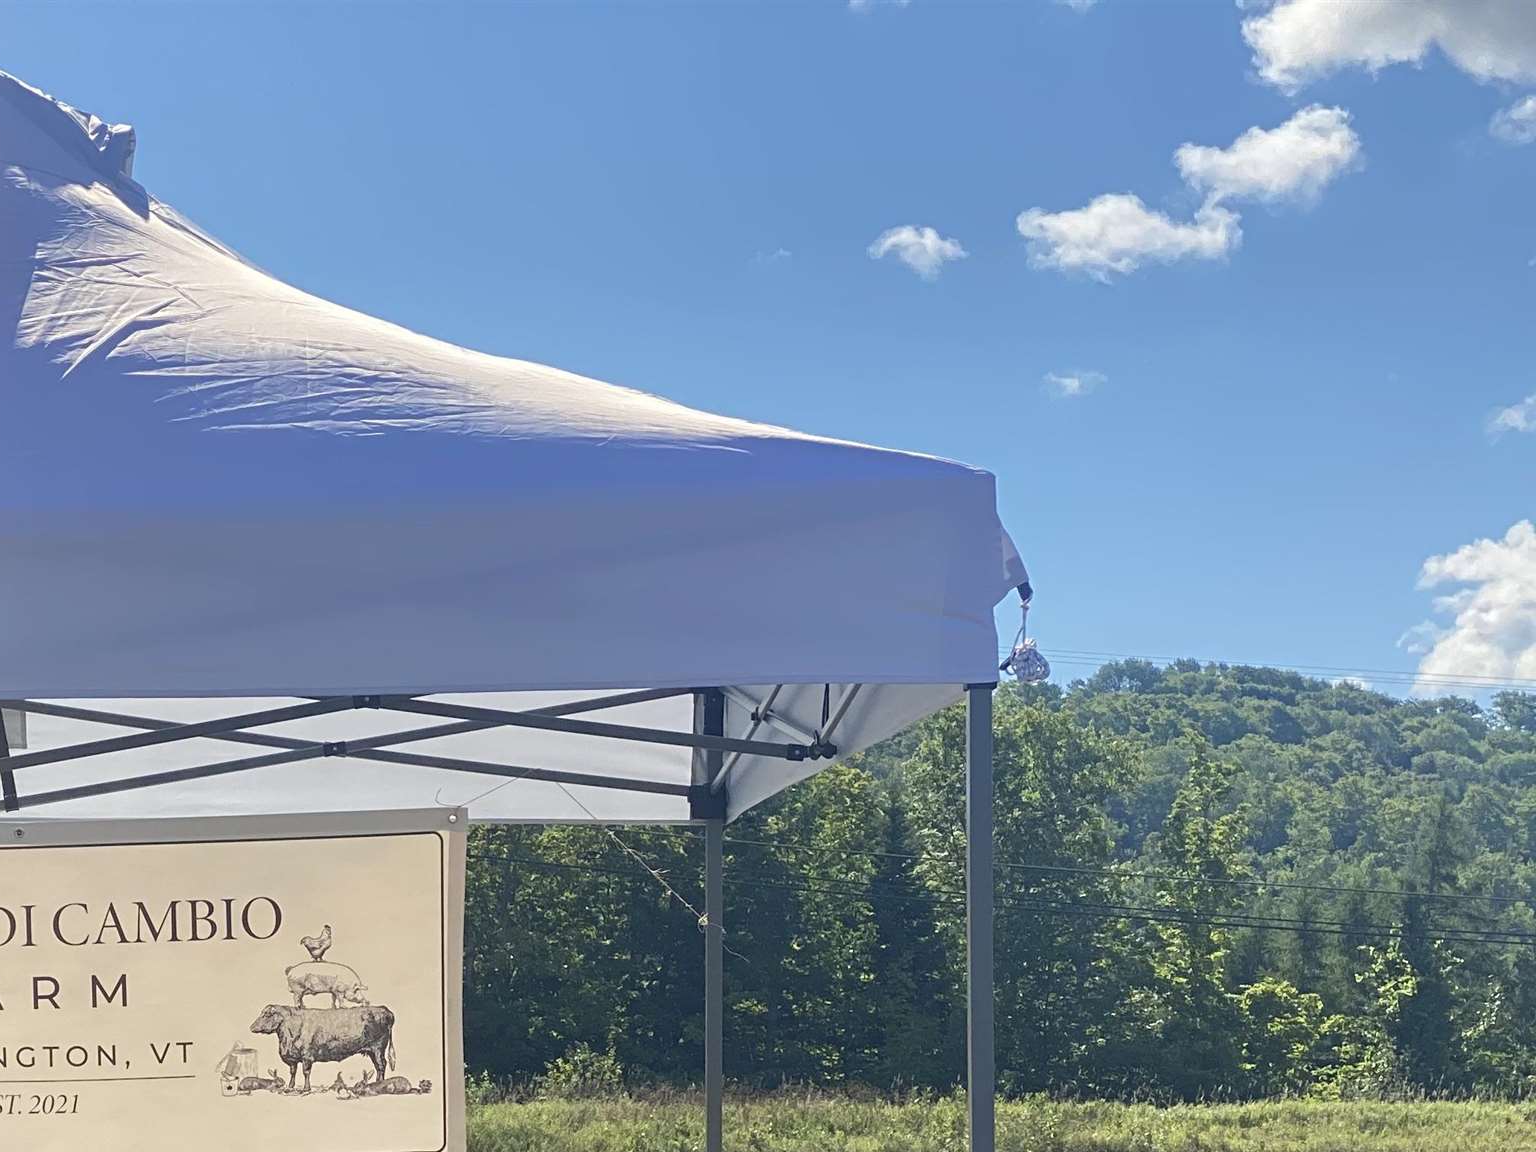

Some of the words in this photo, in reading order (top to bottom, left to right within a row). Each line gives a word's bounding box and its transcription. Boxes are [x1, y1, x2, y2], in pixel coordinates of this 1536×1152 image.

[52, 897, 282, 946] CAMBIO
[150, 1042, 194, 1064] VT
[29, 1094, 80, 1115] 2021
